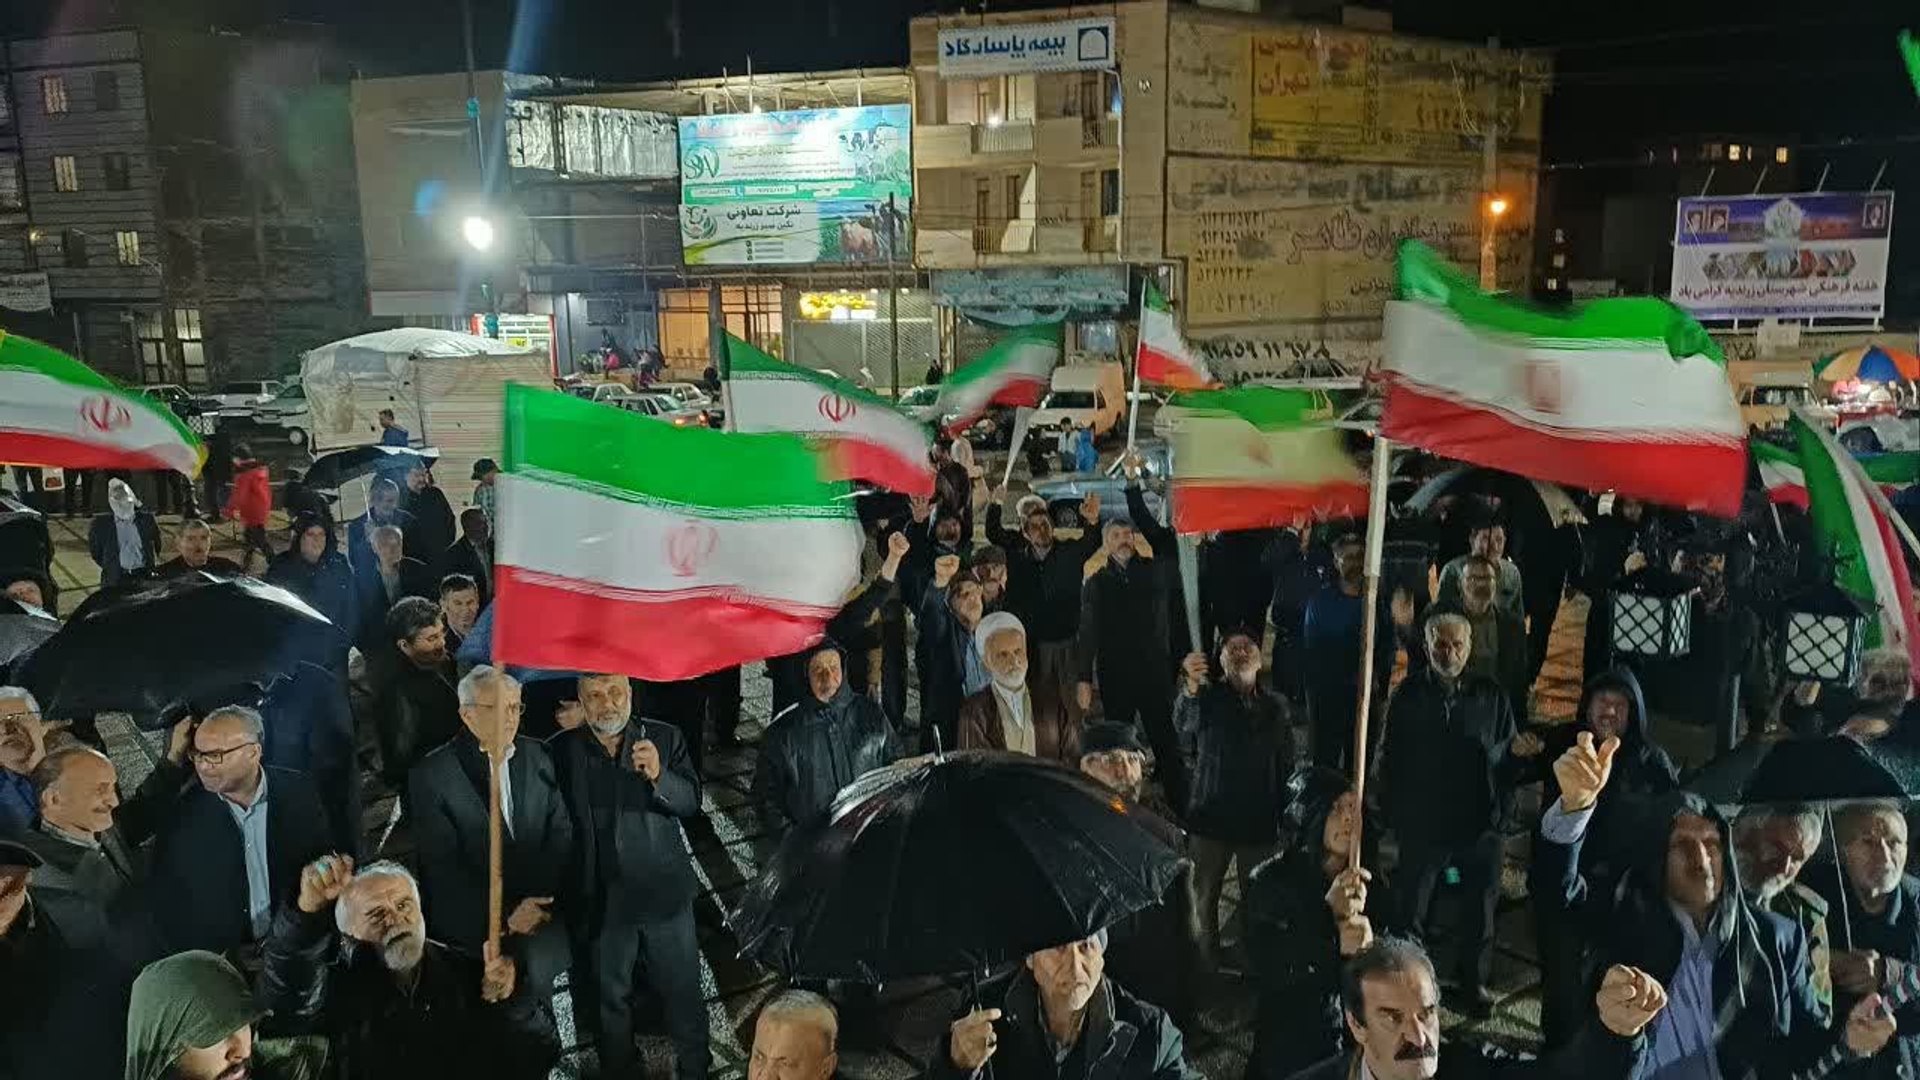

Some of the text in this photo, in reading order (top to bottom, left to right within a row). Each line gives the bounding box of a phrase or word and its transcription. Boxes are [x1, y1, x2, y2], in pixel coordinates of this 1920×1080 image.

[945, 35, 1067, 59] بیمه پاسارگاد
[727, 204, 801, 221] شرکت تعاونی
